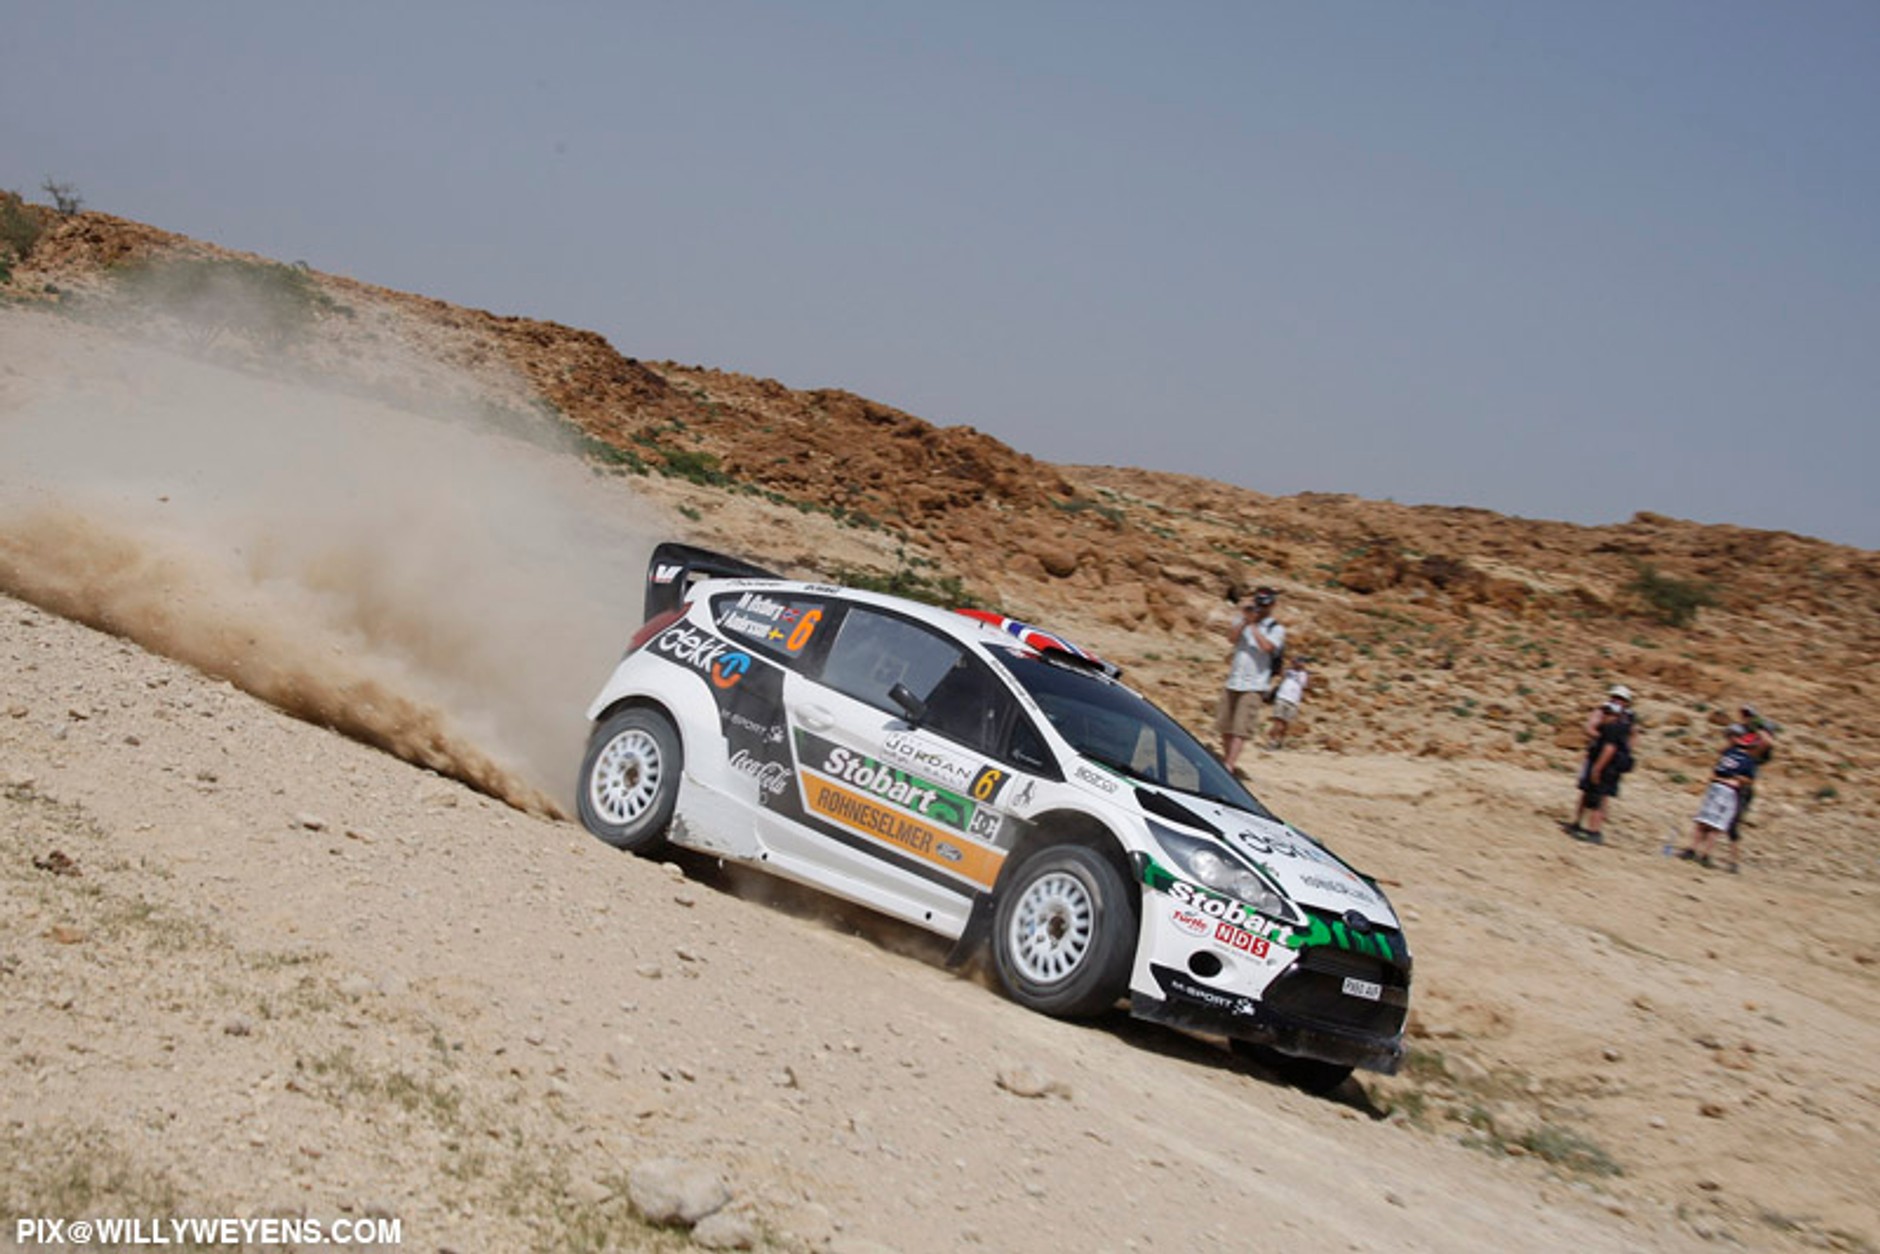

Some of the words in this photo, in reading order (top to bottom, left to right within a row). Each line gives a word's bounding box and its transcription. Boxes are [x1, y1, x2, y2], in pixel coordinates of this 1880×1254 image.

[786, 609, 822, 651] 6
[823, 747, 937, 813] Stobart
[886, 739, 972, 779] JORDAN
[974, 768, 1002, 802] 6
[1168, 880, 1295, 946] Stobart
